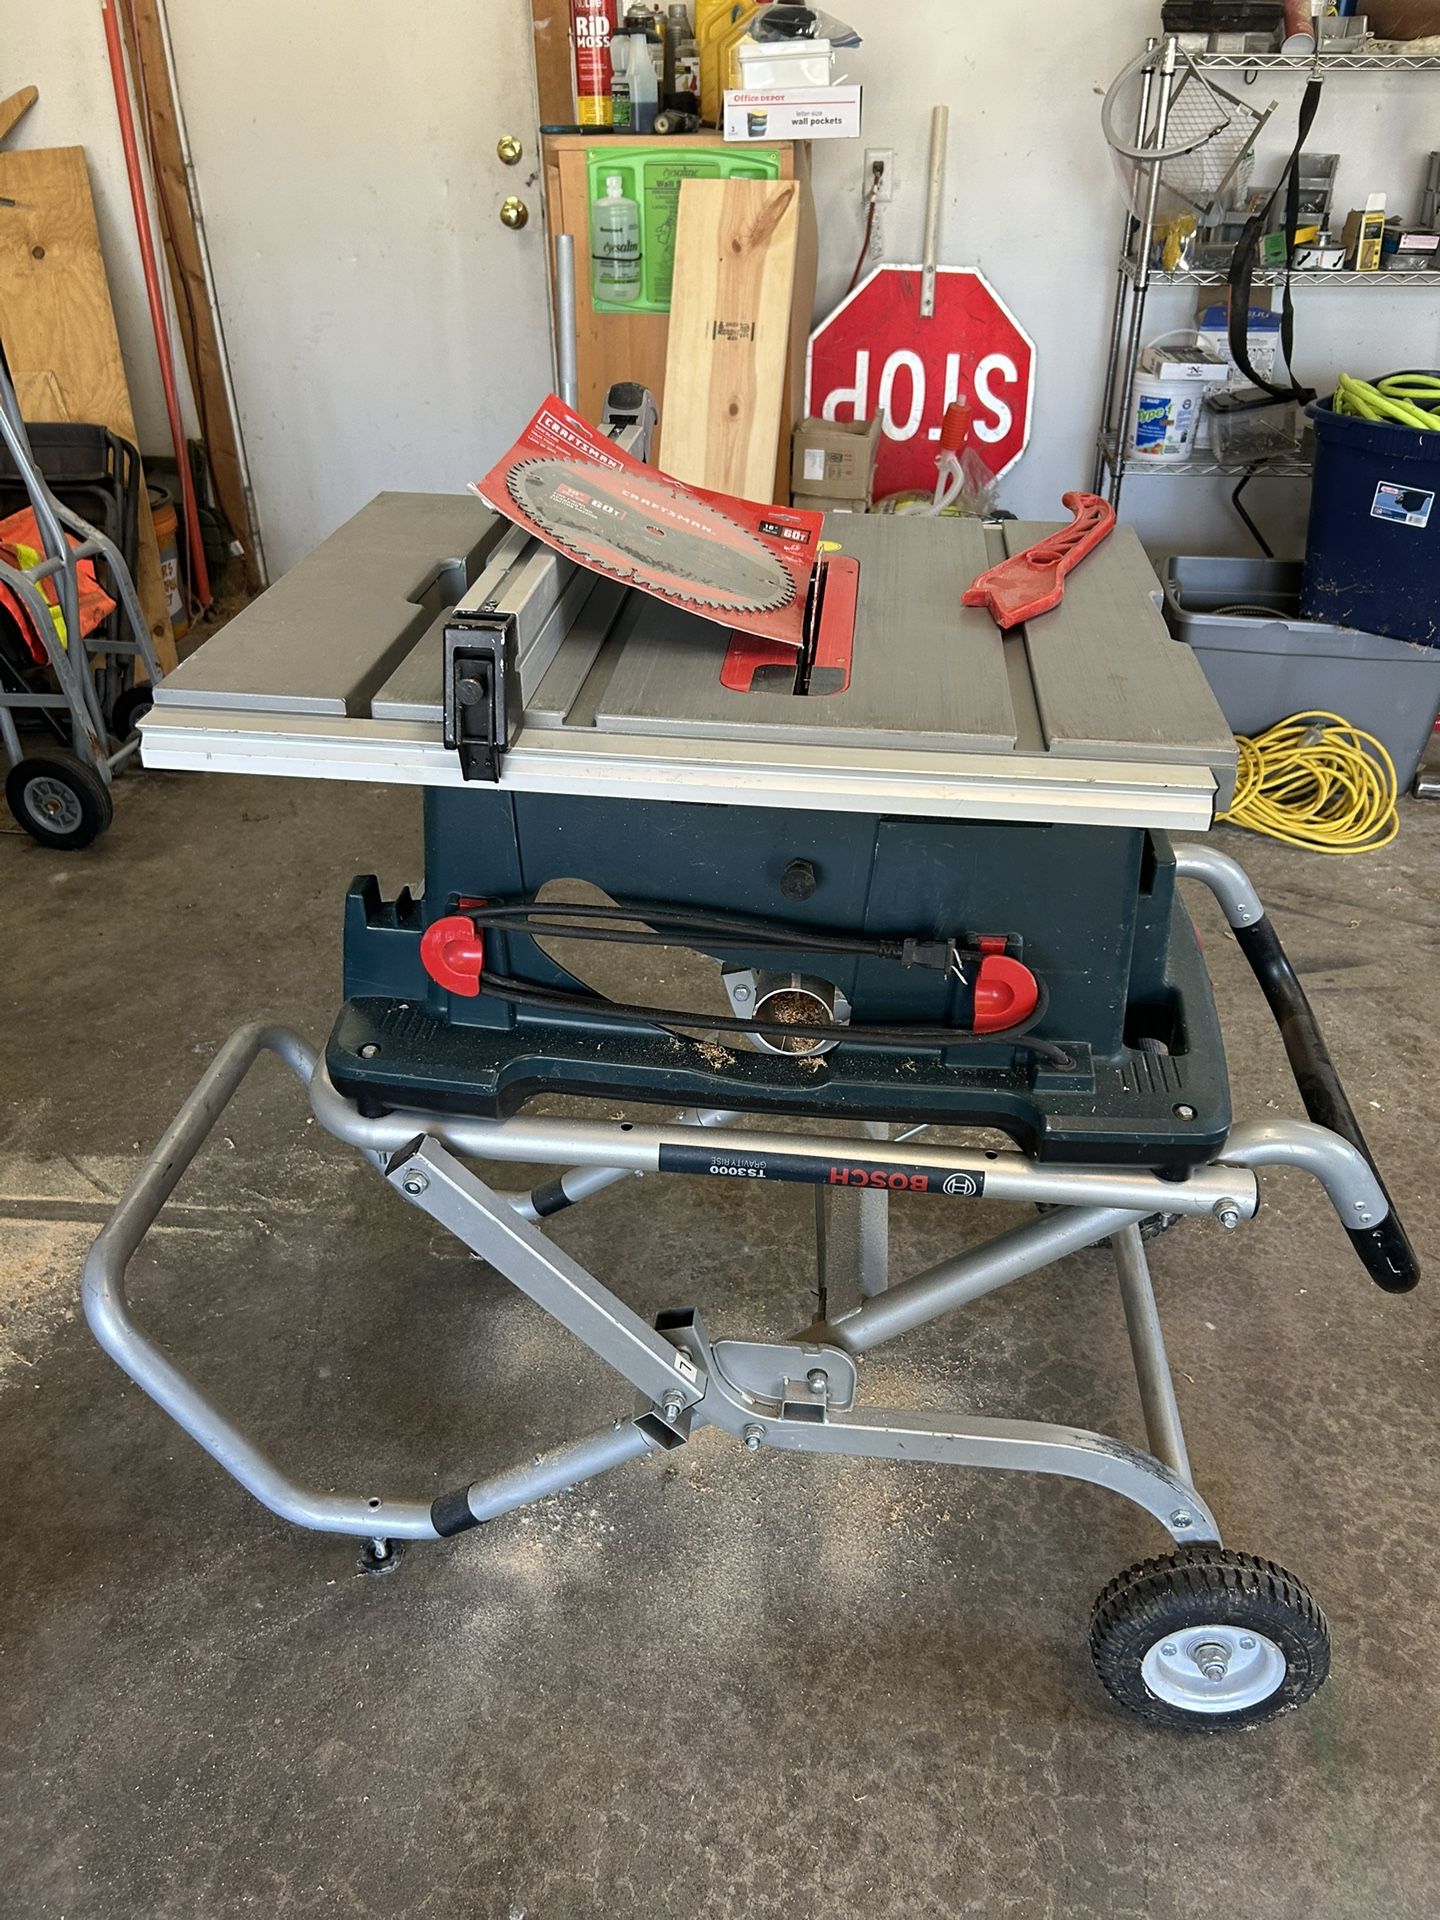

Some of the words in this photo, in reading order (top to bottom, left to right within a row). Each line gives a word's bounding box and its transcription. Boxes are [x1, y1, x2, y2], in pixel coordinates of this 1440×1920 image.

[575, 15, 610, 36] RiD
[576, 36, 611, 48] MOSS
[791, 117, 808, 126] wall
[810, 117, 843, 127] pockets
[822, 349, 1018, 443] STOP
[1137, 408, 1164, 422] Type
[544, 417, 617, 468] CRAFTSMAN
[591, 499, 620, 516] 60T
[622, 490, 712, 533] CRAFTSMAN
[783, 529, 806, 541] 60T
[711, 1156, 730, 1166] RISE
[730, 1157, 767, 1169] GRAVITY
[709, 1165, 766, 1178] TS3000
[830, 1167, 929, 1192] BOSCH
